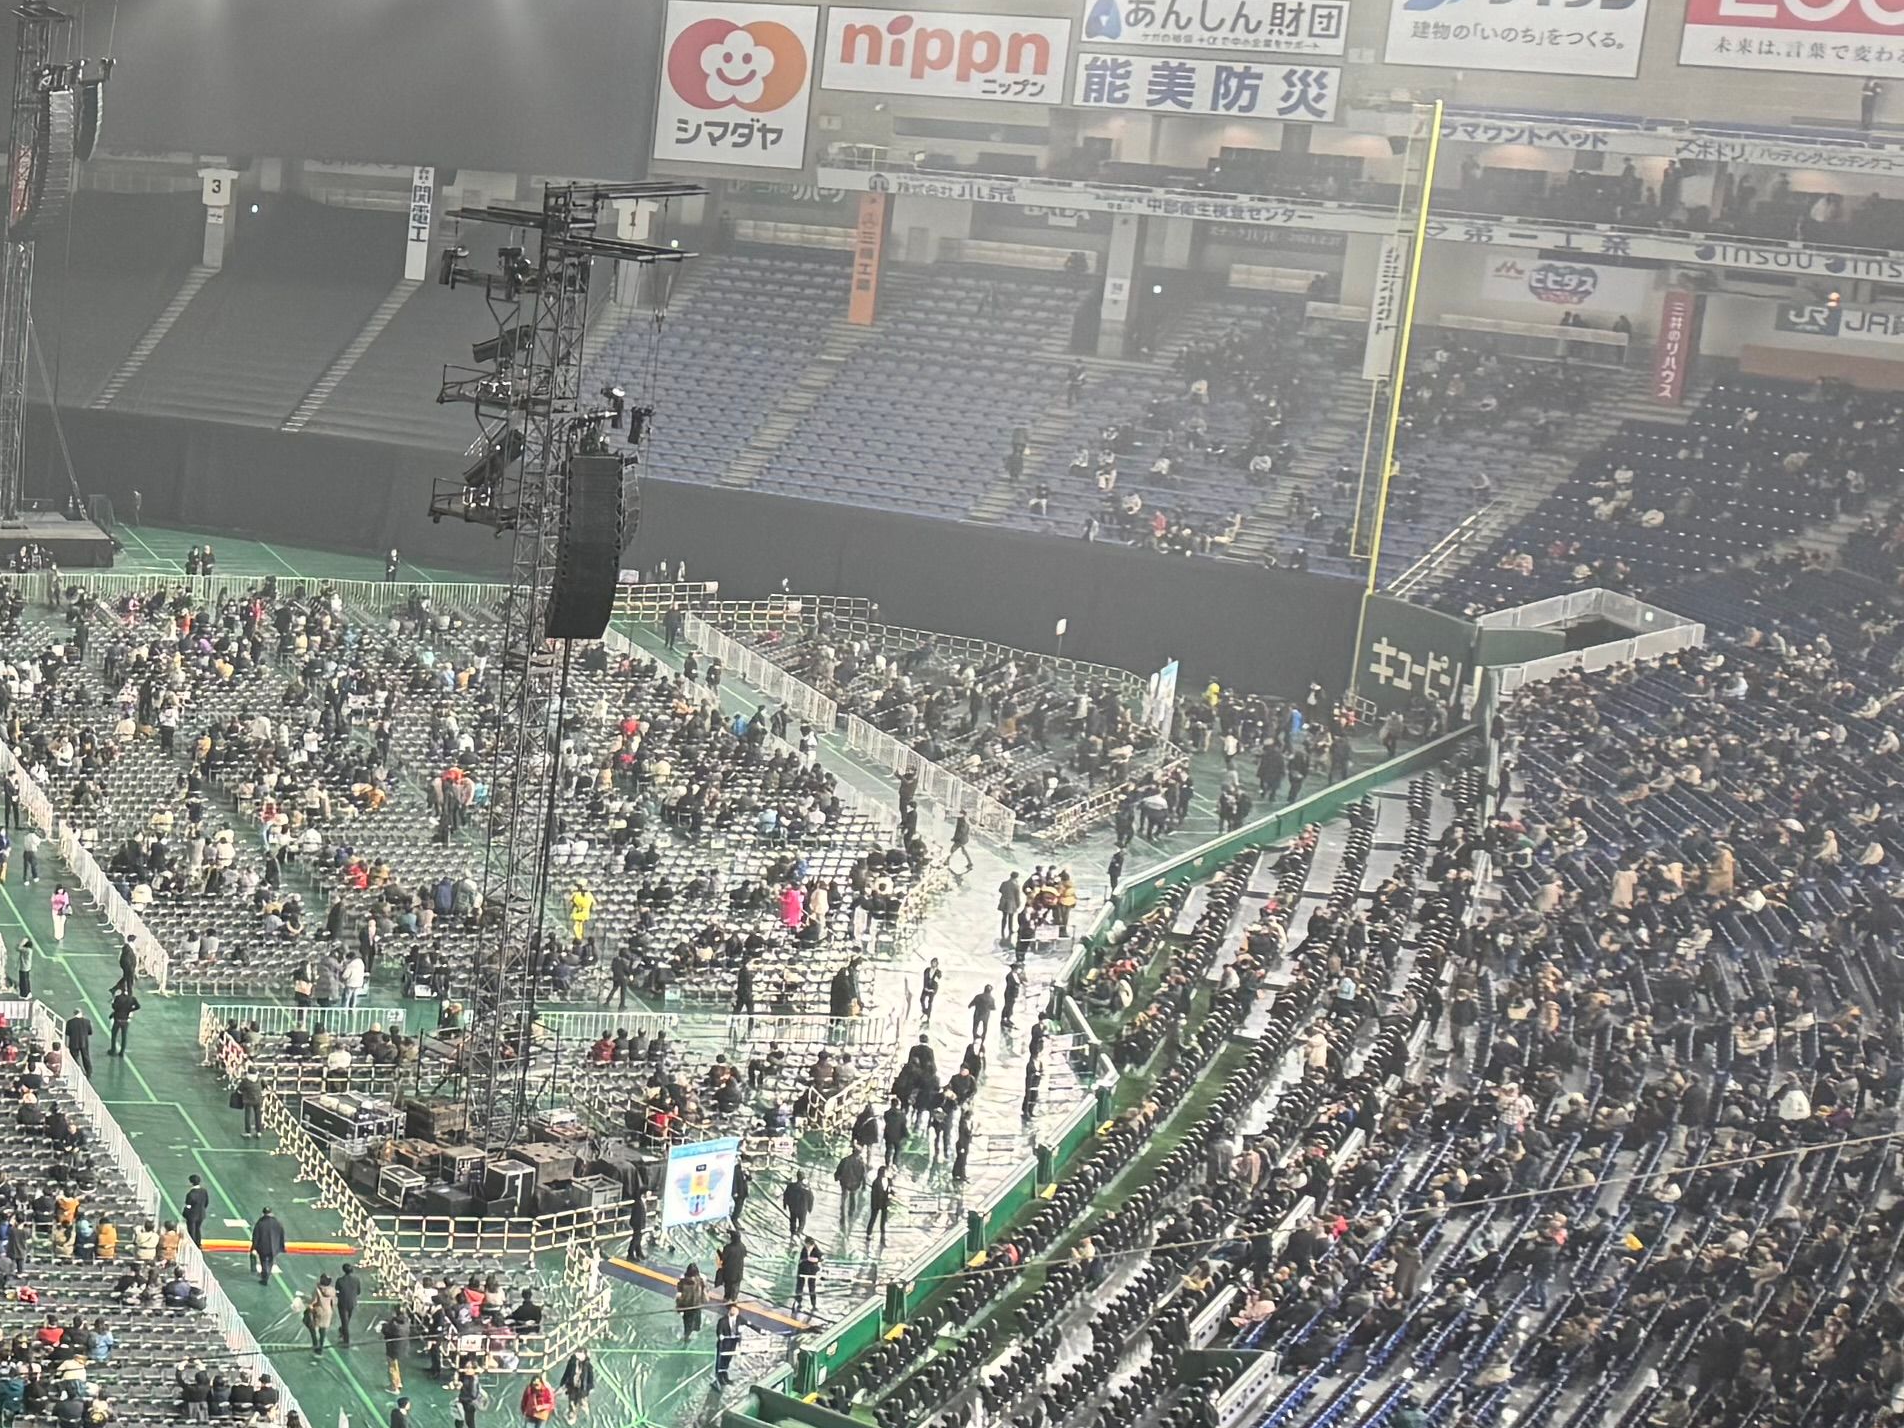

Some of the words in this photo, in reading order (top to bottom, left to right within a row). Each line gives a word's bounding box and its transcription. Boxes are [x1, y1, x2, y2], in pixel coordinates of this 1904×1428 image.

[840, 15, 1050, 83] nippn
[1410, 21, 1624, 50] 建物の「いのち」をつくる。
[982, 79, 1045, 97] ニップン
[1082, 56, 1328, 118] 能美防災
[675, 117, 784, 151] シマダヤ
[212, 179, 221, 194] 3
[1789, 306, 1830, 326] JR
[1657, 302, 1686, 398] 三井のリハウス
